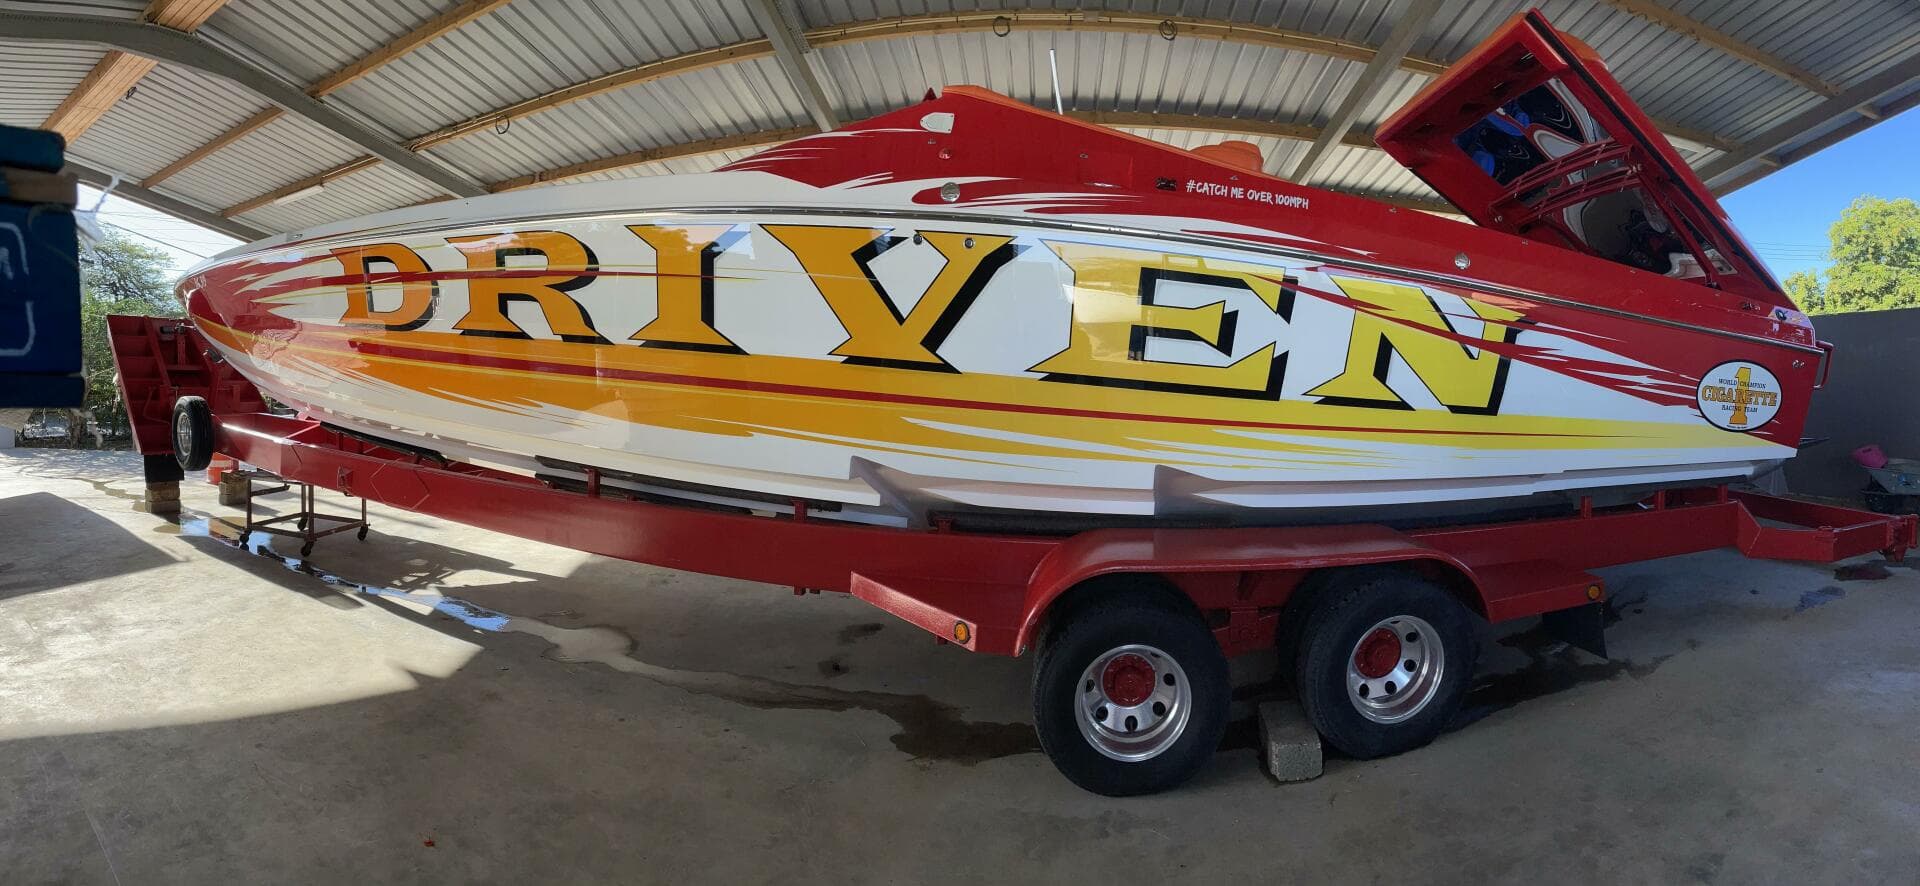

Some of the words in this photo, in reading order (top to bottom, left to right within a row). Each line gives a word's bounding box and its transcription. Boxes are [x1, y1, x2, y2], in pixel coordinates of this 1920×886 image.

[1186, 180, 1228, 196] #CATCH
[1230, 187, 1244, 199] ME
[1247, 189, 1273, 205] OVER
[1275, 194, 1309, 210] 100MPH
[329, 224, 1536, 416] DRIVEN
[1718, 378, 1737, 386] WORLD
[1739, 381, 1766, 389] CHAMPION
[1702, 385, 1778, 407] CIGARETTE
[1721, 404, 1741, 412] RACING
